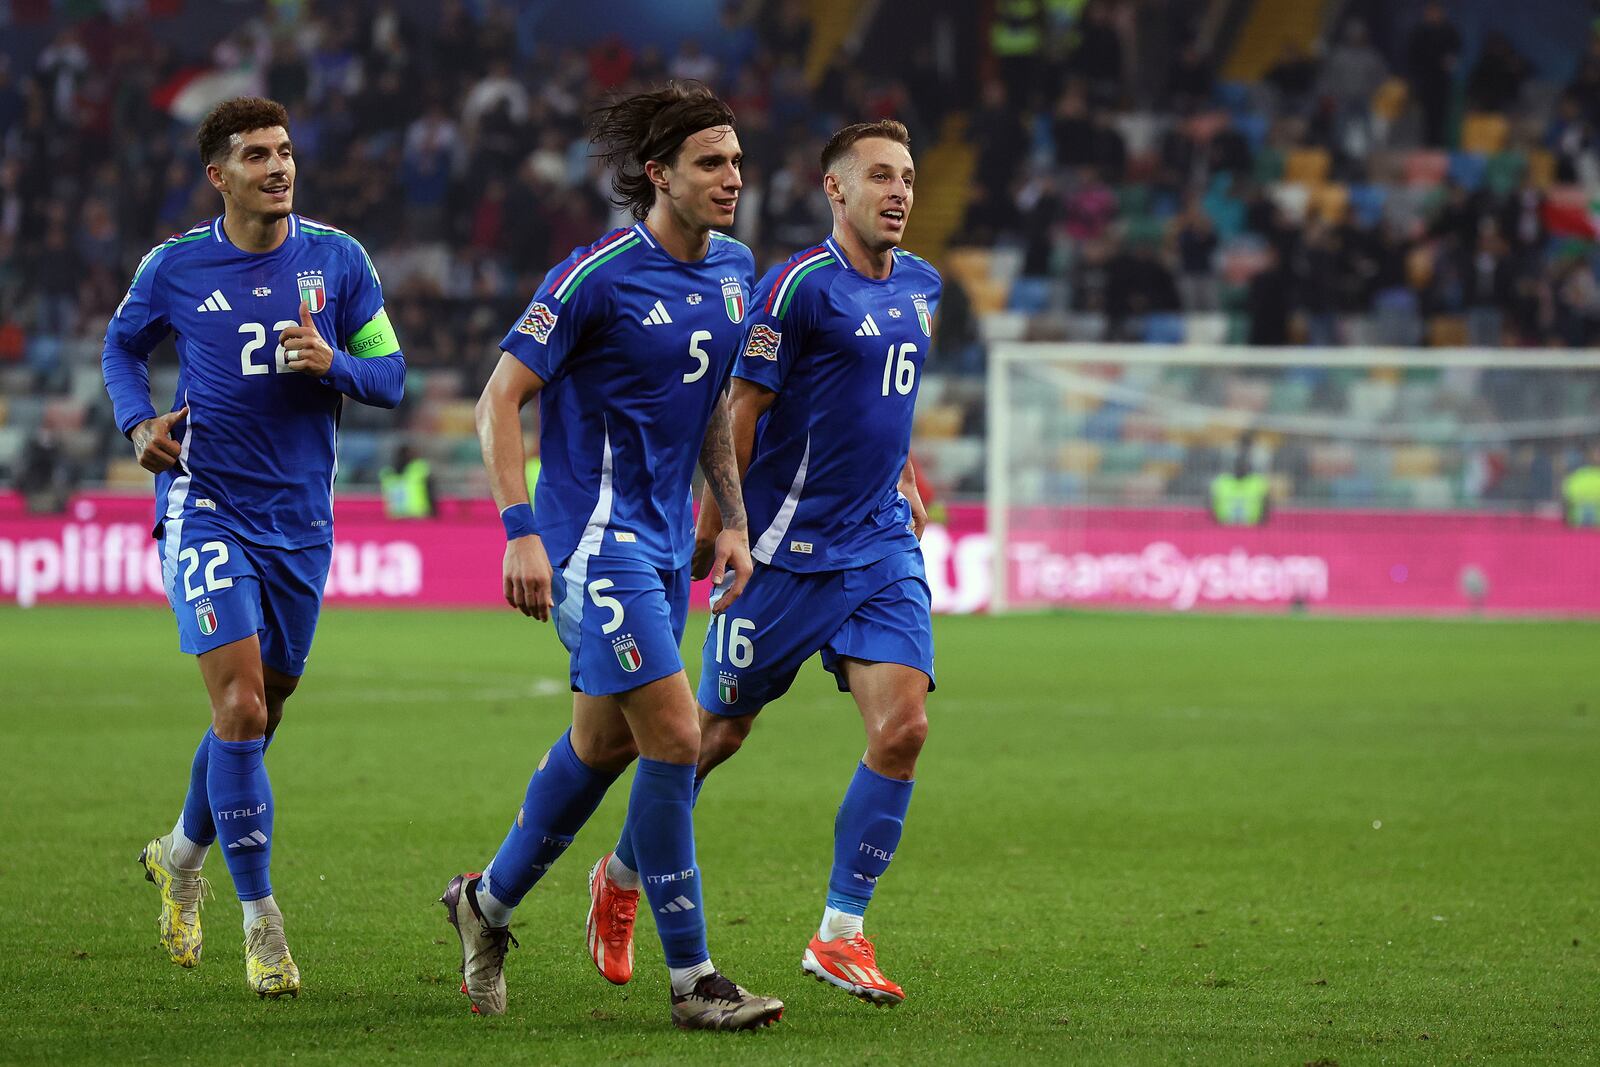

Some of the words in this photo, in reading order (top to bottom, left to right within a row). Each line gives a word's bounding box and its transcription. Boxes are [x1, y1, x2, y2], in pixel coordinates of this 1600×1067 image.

[300, 278, 321, 287] ITALIA
[682, 330, 712, 384] 5
[881, 342, 919, 396] 16
[178, 541, 234, 602] 22
[1012, 541, 1329, 611] TeamSystem
[587, 578, 625, 635] 5
[615, 640, 634, 652] ITALIA
[715, 613, 756, 668] 16
[217, 802, 267, 820] ITALIA
[646, 868, 695, 885] ITALIA
